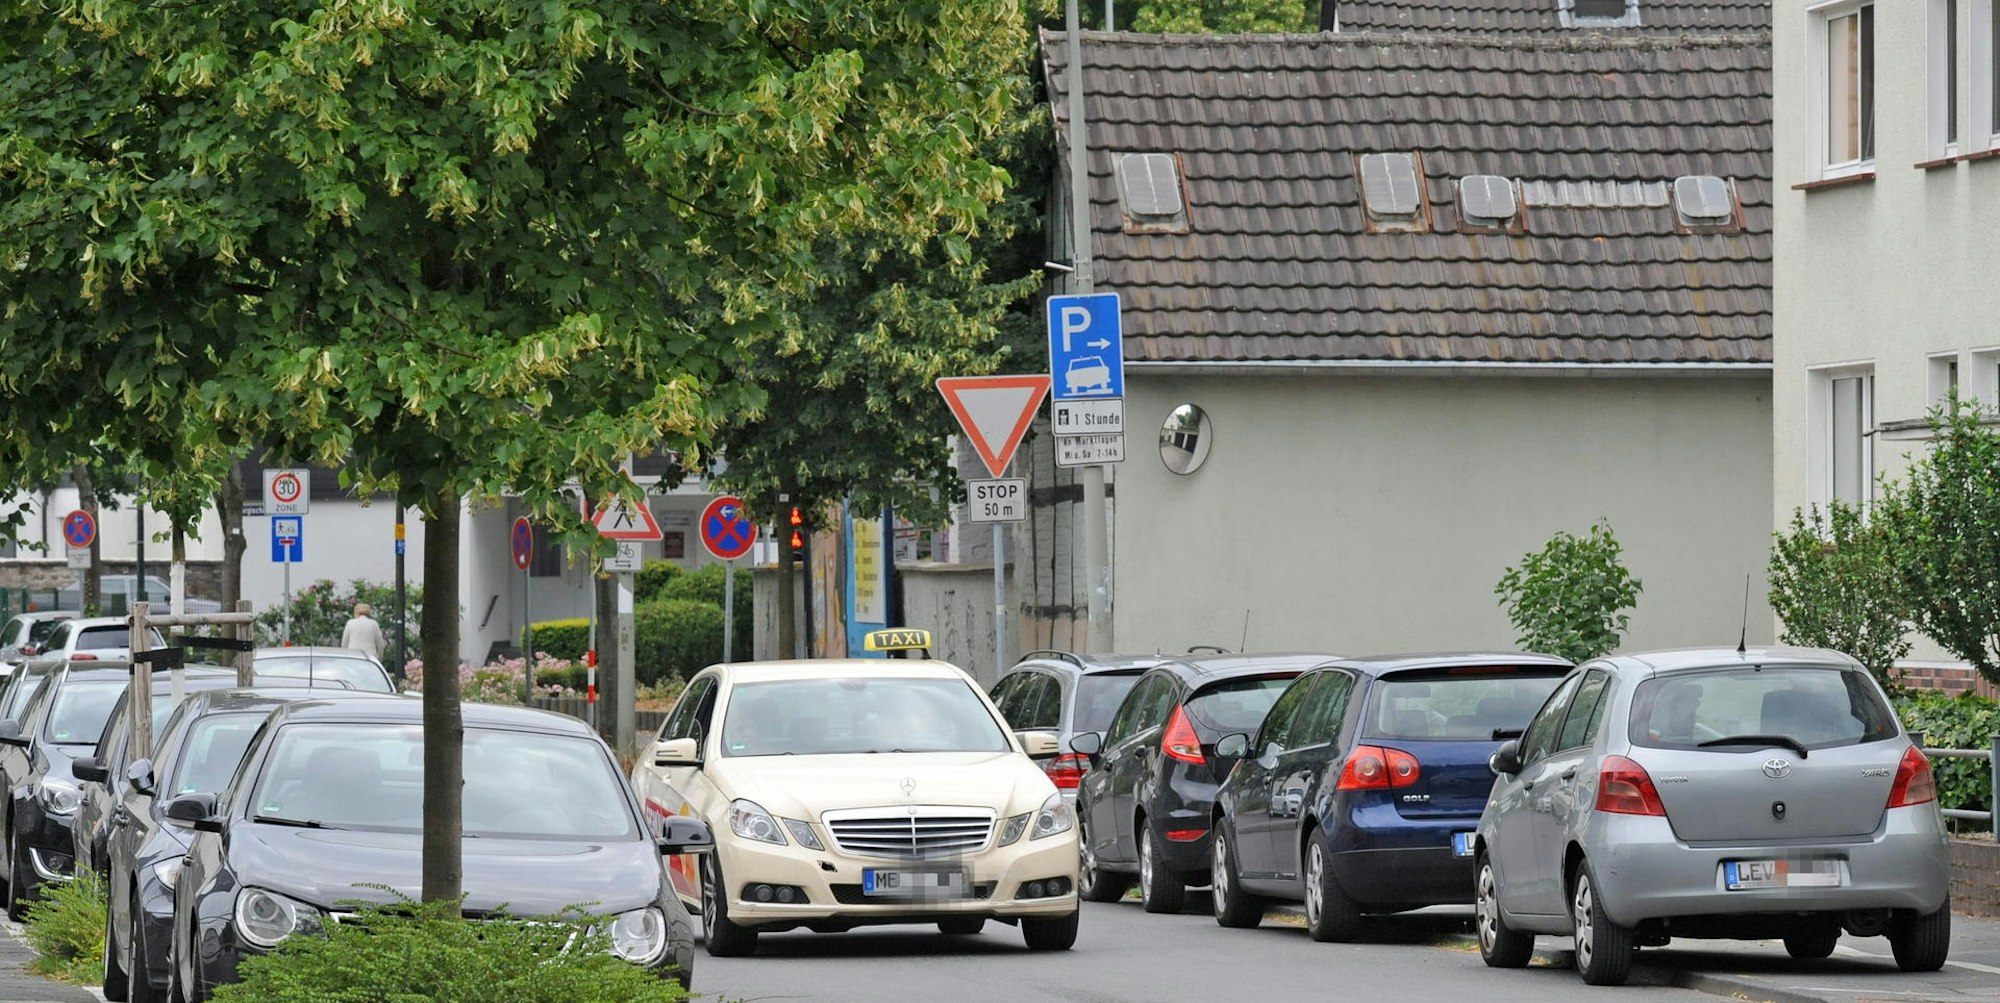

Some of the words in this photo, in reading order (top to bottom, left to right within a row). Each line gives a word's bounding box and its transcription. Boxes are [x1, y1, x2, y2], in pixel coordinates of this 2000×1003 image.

[1061, 305, 1092, 353] P
[1075, 413, 1079, 426] 1
[1085, 412, 1120, 425] Stunde
[1082, 450, 1091, 458] Sa
[278, 479, 295, 495] 30
[977, 485, 1018, 499] STOP
[275, 504, 299, 512] ZONE
[984, 502, 999, 516] 50
[1002, 505, 1013, 516] m
[877, 632, 922, 646] TAXI
[1659, 775, 1688, 783] TOYOTA
[1402, 794, 1431, 802] GOLF
[1737, 862, 1774, 881] LEV
[875, 872, 898, 889] ME
